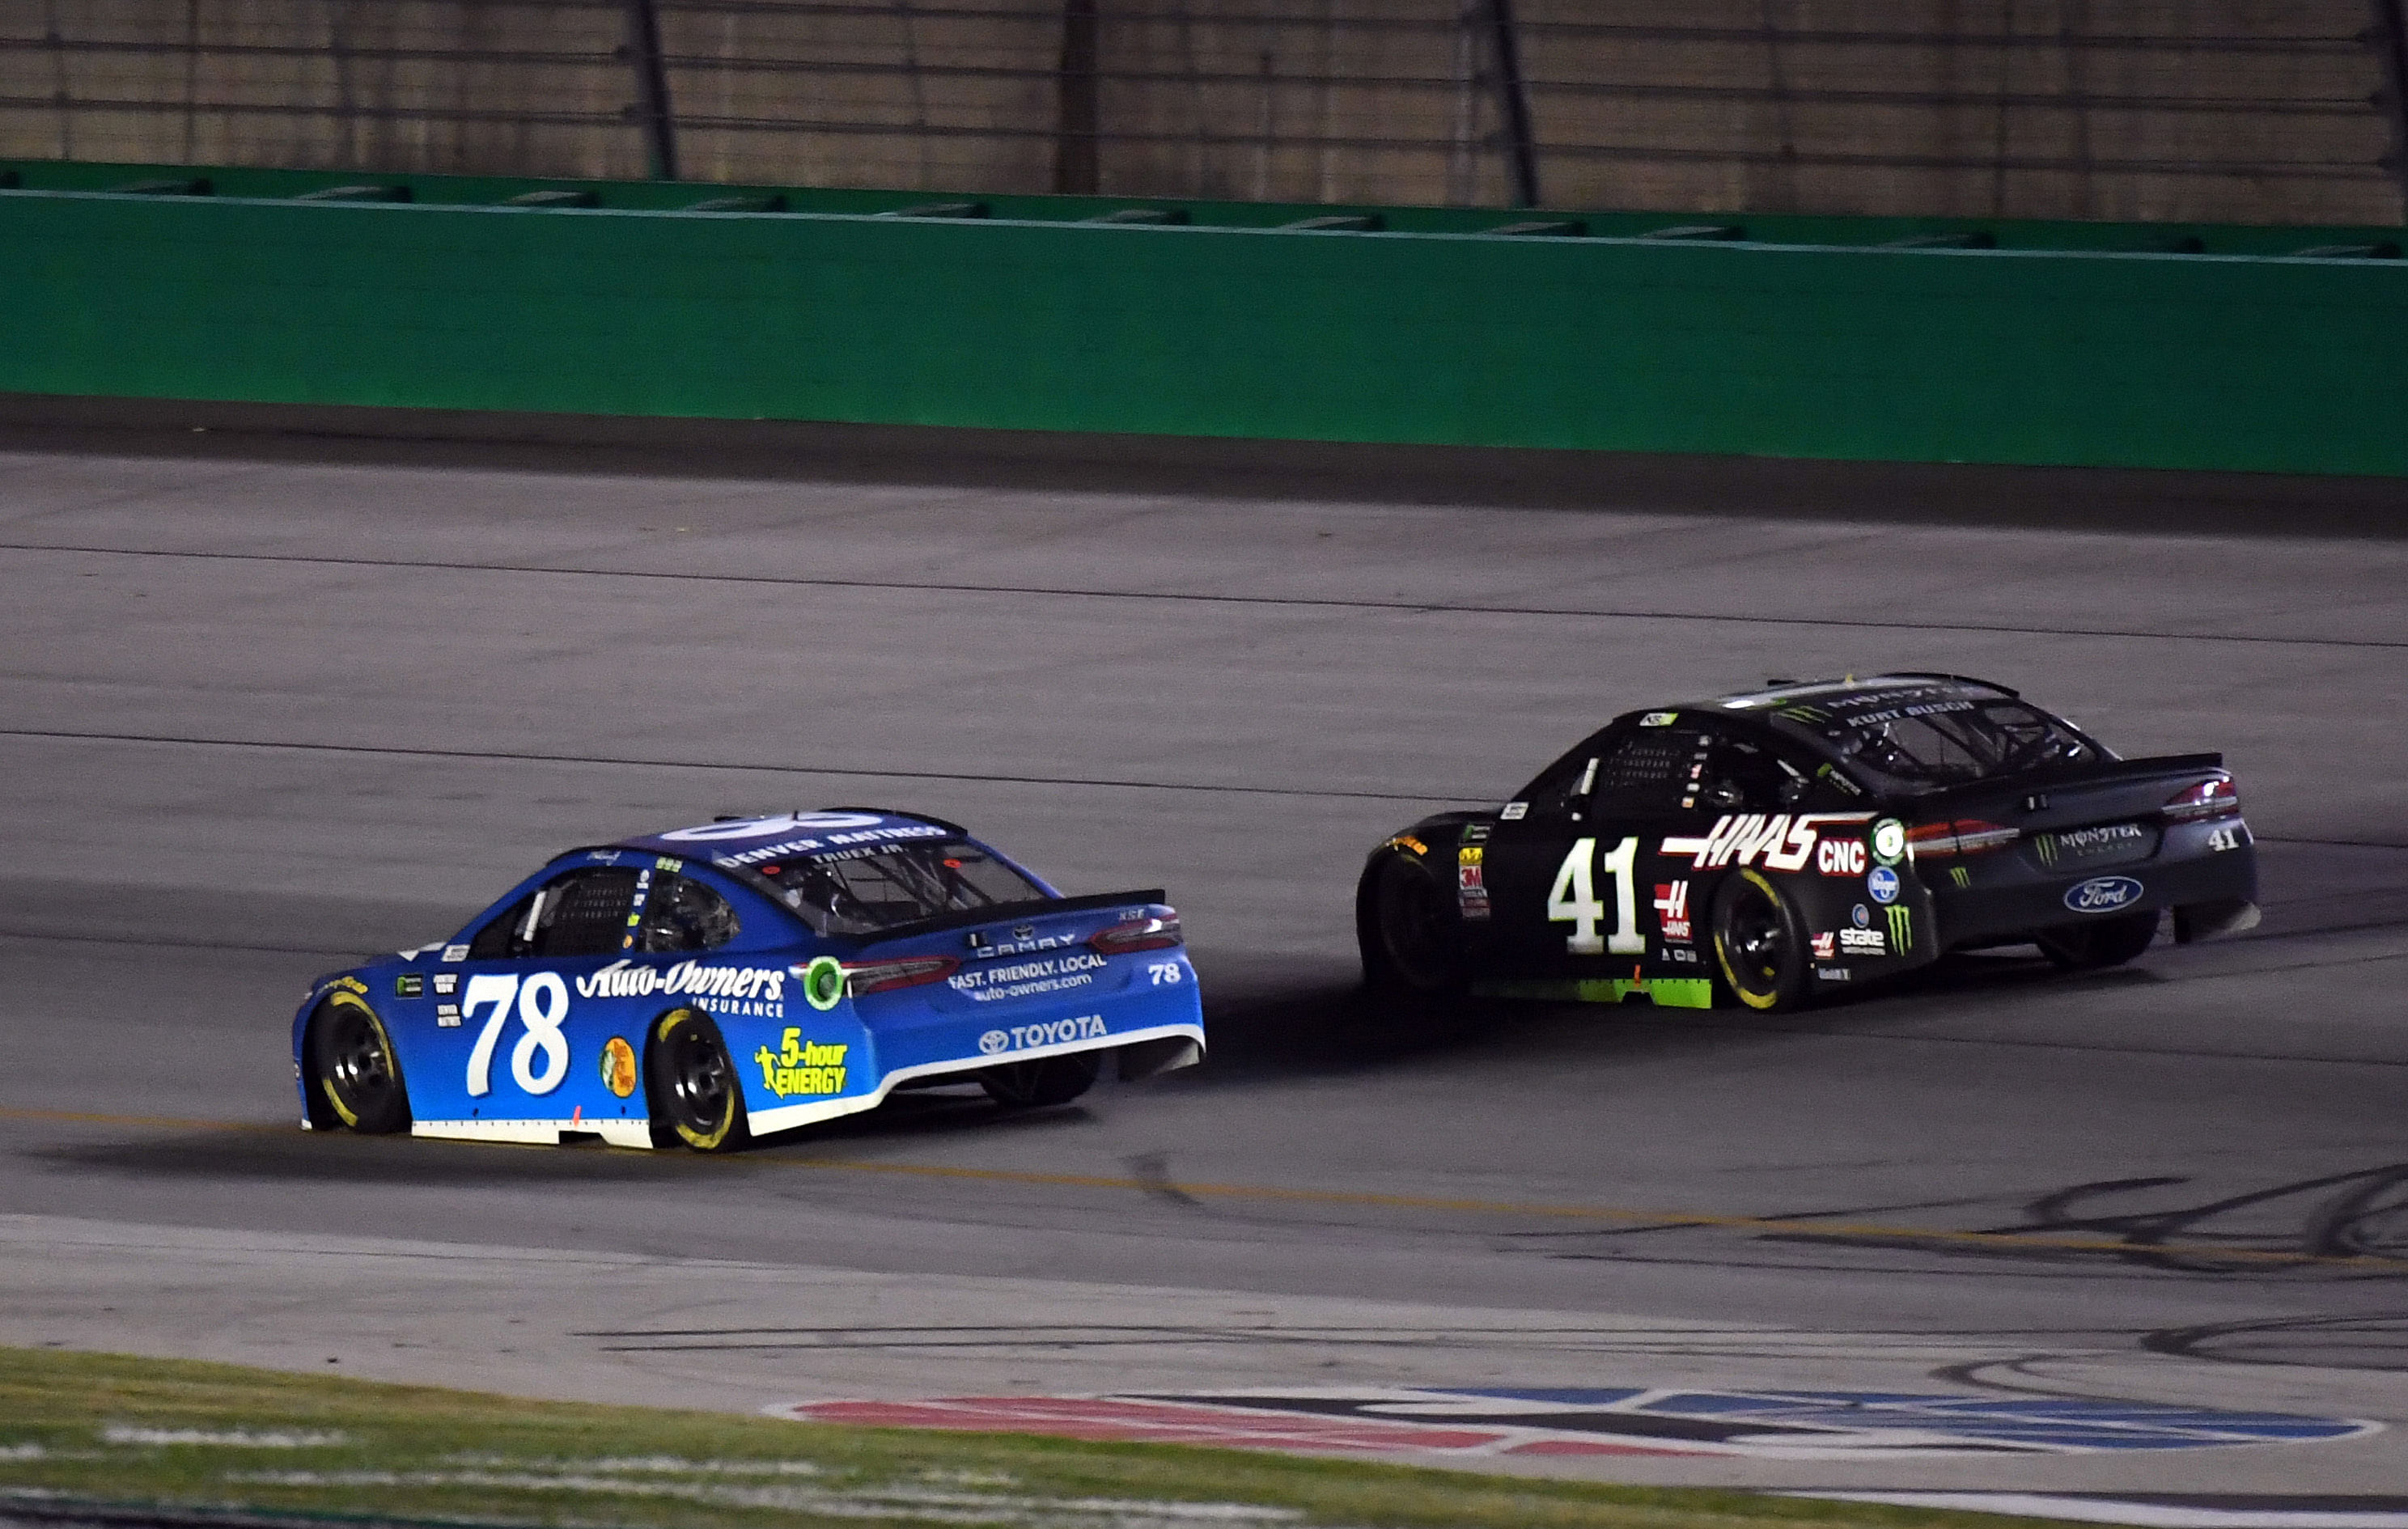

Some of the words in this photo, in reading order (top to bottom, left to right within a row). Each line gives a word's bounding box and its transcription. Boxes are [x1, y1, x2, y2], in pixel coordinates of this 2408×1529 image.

[1846, 709, 1901, 726] KURT
[1905, 701, 1975, 718] BUSCH
[714, 838, 825, 868] DENVER
[1660, 811, 1879, 870] HAAS
[1818, 840, 1865, 875] CNC
[2208, 828, 2240, 852] 41
[811, 846, 876, 865] TRUEX
[1461, 866, 1482, 887] 3M
[1548, 836, 1646, 955] 41
[2079, 881, 2128, 908] Ford
[1839, 927, 1885, 947] state
[575, 958, 785, 1002] Auto-Owners
[948, 971, 986, 989] FAST.
[989, 961, 1058, 985] FRIENDLY.
[1060, 954, 1107, 973] LOCAL
[1148, 963, 1181, 985] 78
[974, 973, 1092, 1002] auto-owners.com
[692, 997, 784, 1019] INSURANCE
[462, 971, 570, 1098] 78
[1011, 1014, 1108, 1050] TOYOTA
[781, 1027, 848, 1067] 5-hour
[776, 1066, 847, 1094] ENERGY
